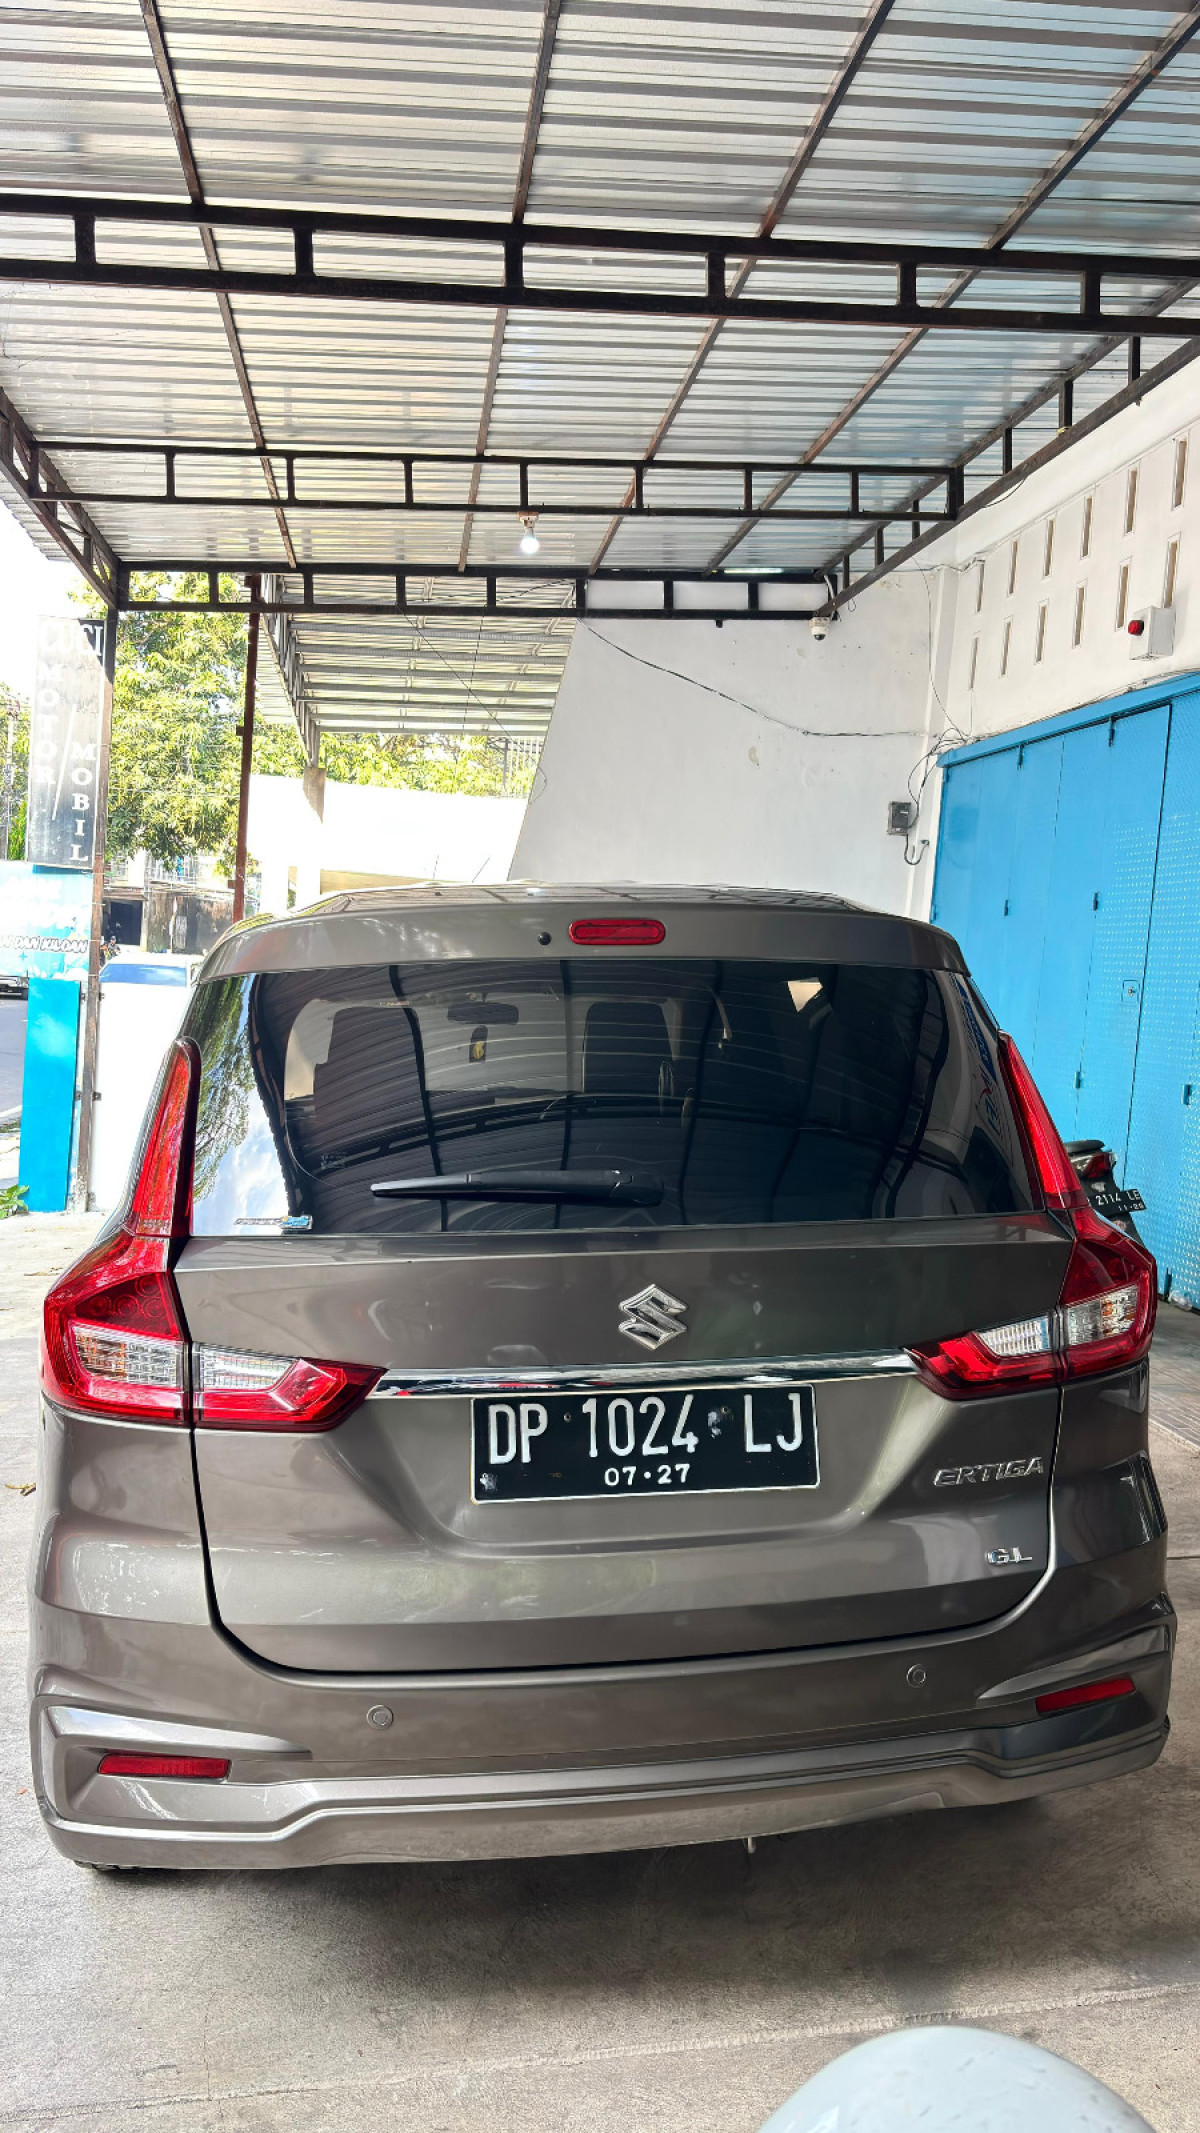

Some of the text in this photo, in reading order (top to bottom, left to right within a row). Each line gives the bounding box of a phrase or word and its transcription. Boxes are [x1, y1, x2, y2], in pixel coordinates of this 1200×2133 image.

[41, 622, 104, 657] CUCI
[36, 662, 62, 786] MOTOR
[70, 742, 97, 861] MOBIL
[1095, 1192, 1122, 1206] 2114
[488, 1392, 803, 1466] DP 1024 LJ
[932, 1456, 1044, 1488] ERTIGA
[985, 1547, 1033, 1566] GL
